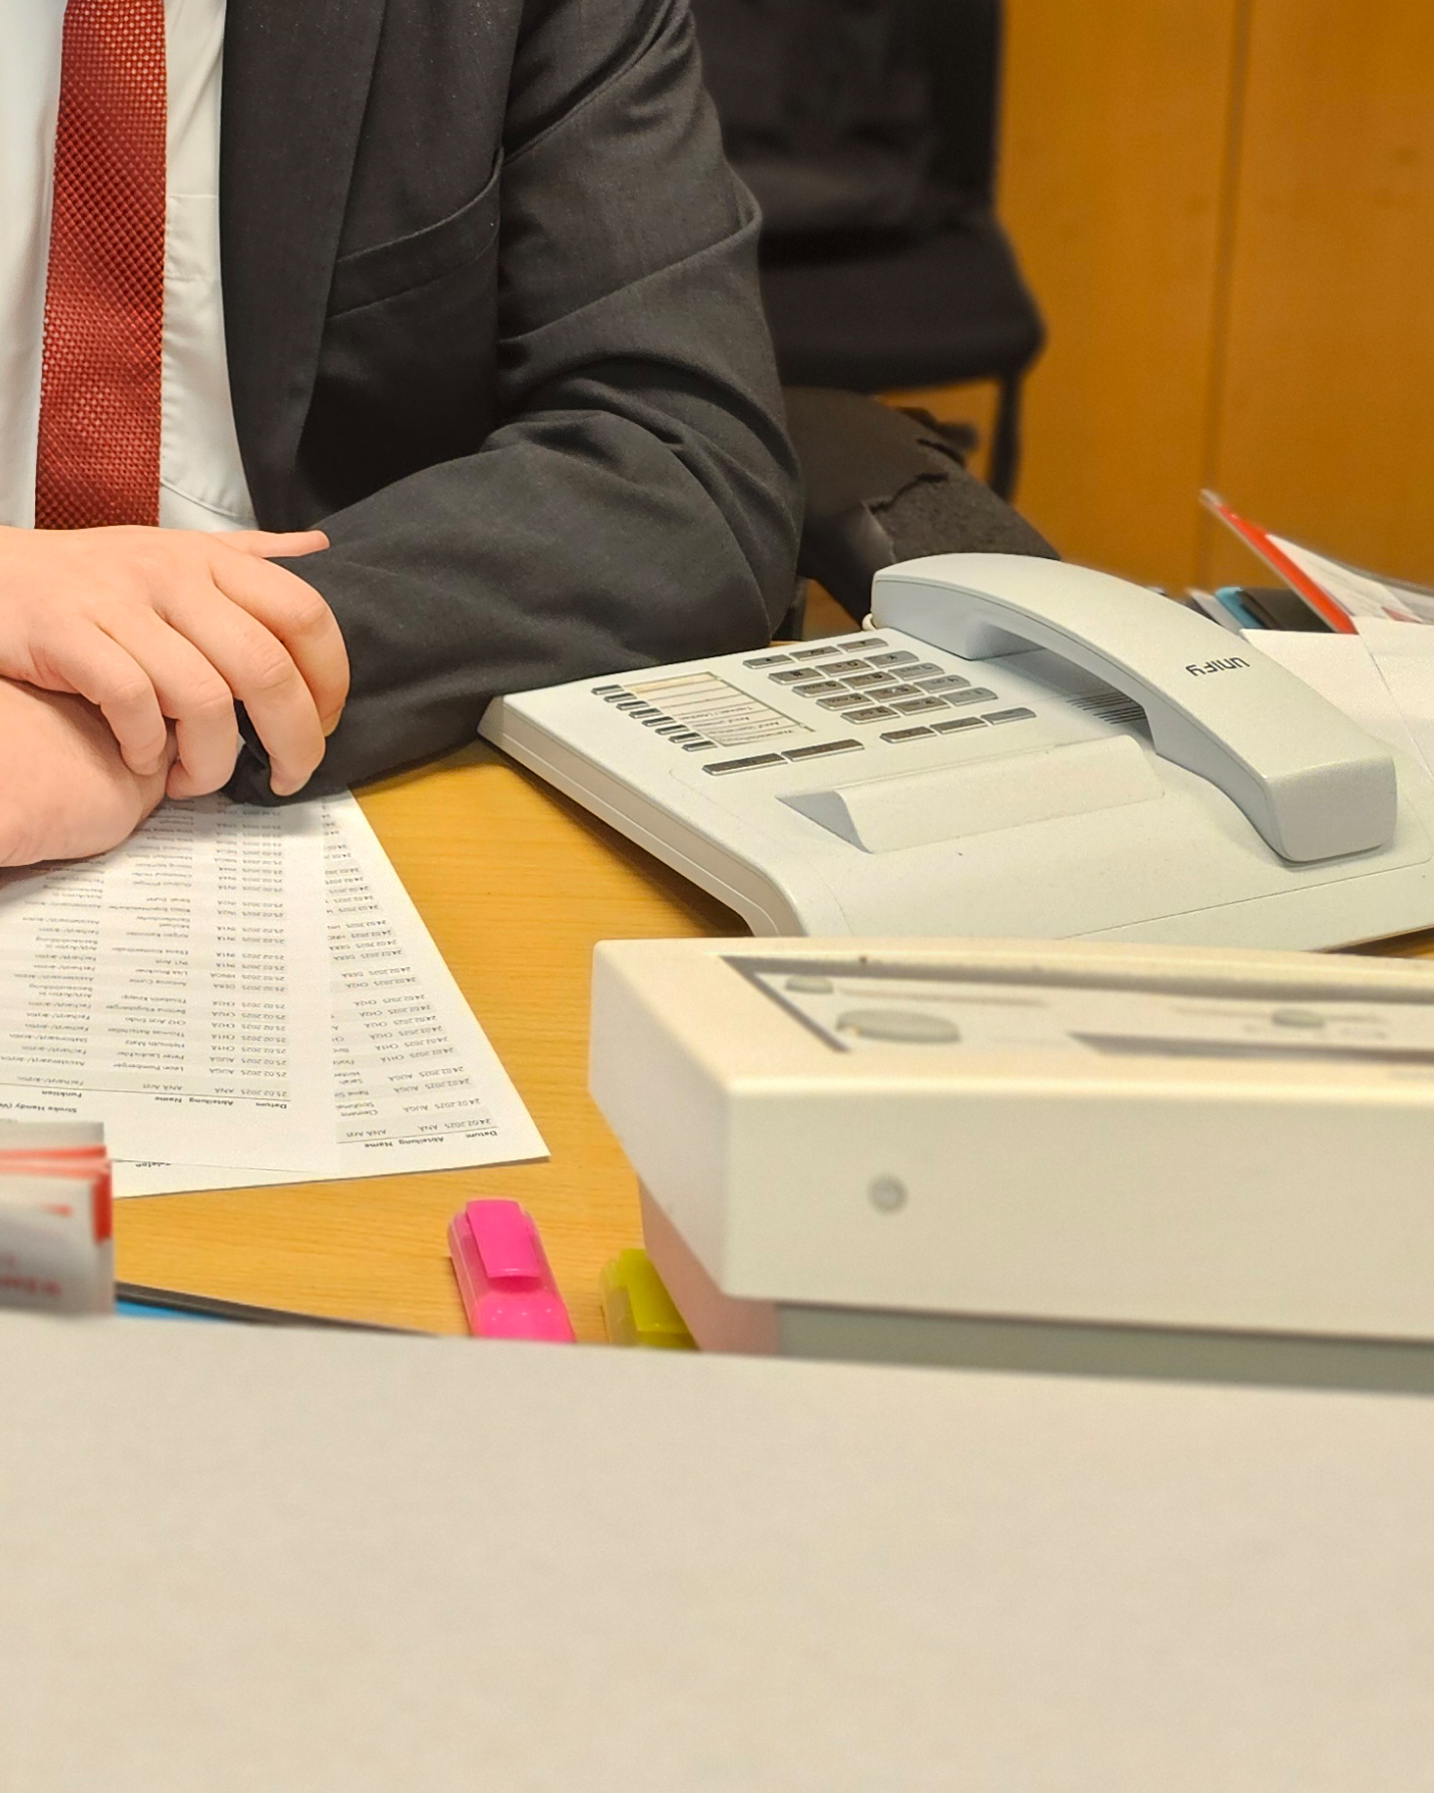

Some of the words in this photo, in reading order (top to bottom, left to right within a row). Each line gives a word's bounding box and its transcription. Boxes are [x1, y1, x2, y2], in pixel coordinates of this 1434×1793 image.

[41, 1090, 82, 1098] Funktion
[241, 1088, 287, 1097] 25.02.2025
[189, 1097, 234, 1106] Abteilung
[15, 1103, 45, 1111] Handy
[47, 1105, 77, 1113] Stroke
[466, 1130, 497, 1139] Datum
[365, 1141, 392, 1149] Name
[399, 1136, 444, 1146] Abteilung
